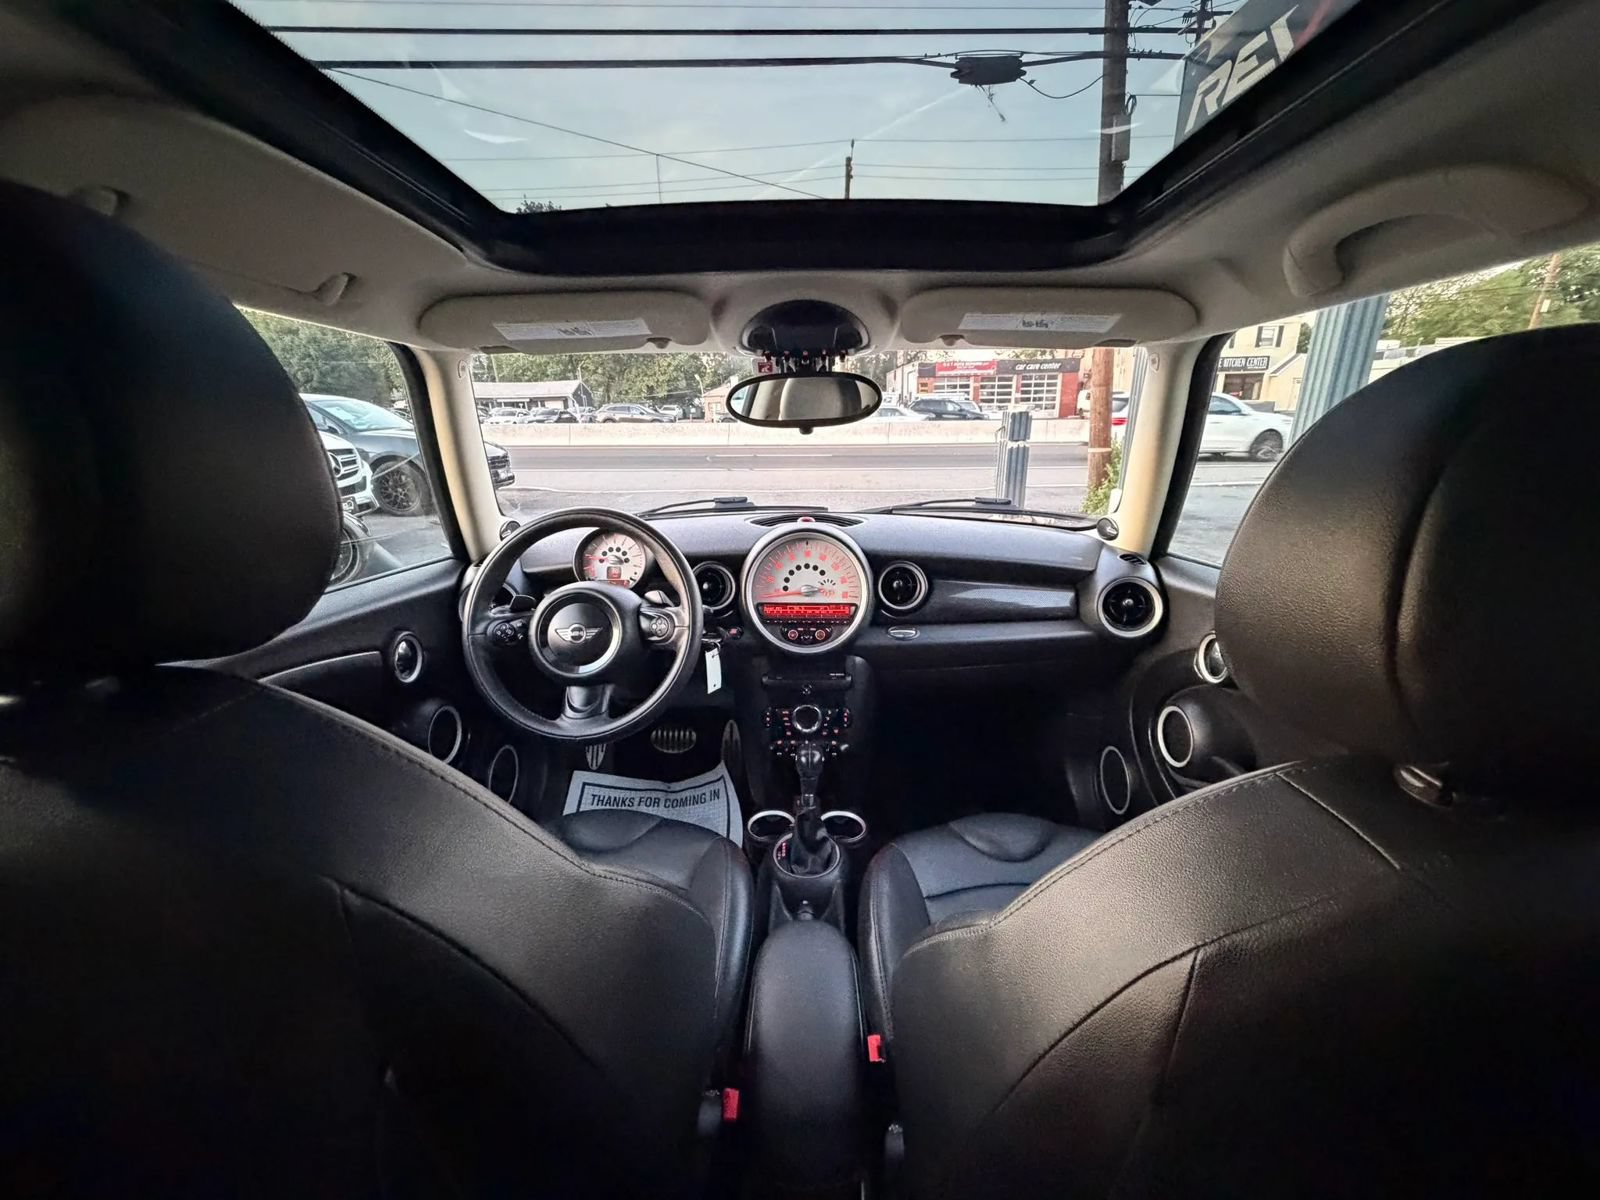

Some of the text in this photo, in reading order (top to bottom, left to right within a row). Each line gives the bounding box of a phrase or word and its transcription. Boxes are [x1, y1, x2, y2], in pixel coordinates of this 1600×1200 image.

[1223, 358, 1246, 367] KITCHEN
[1246, 357, 1268, 367] CENTER
[591, 788, 720, 809] THANKS FOR COMING IN
